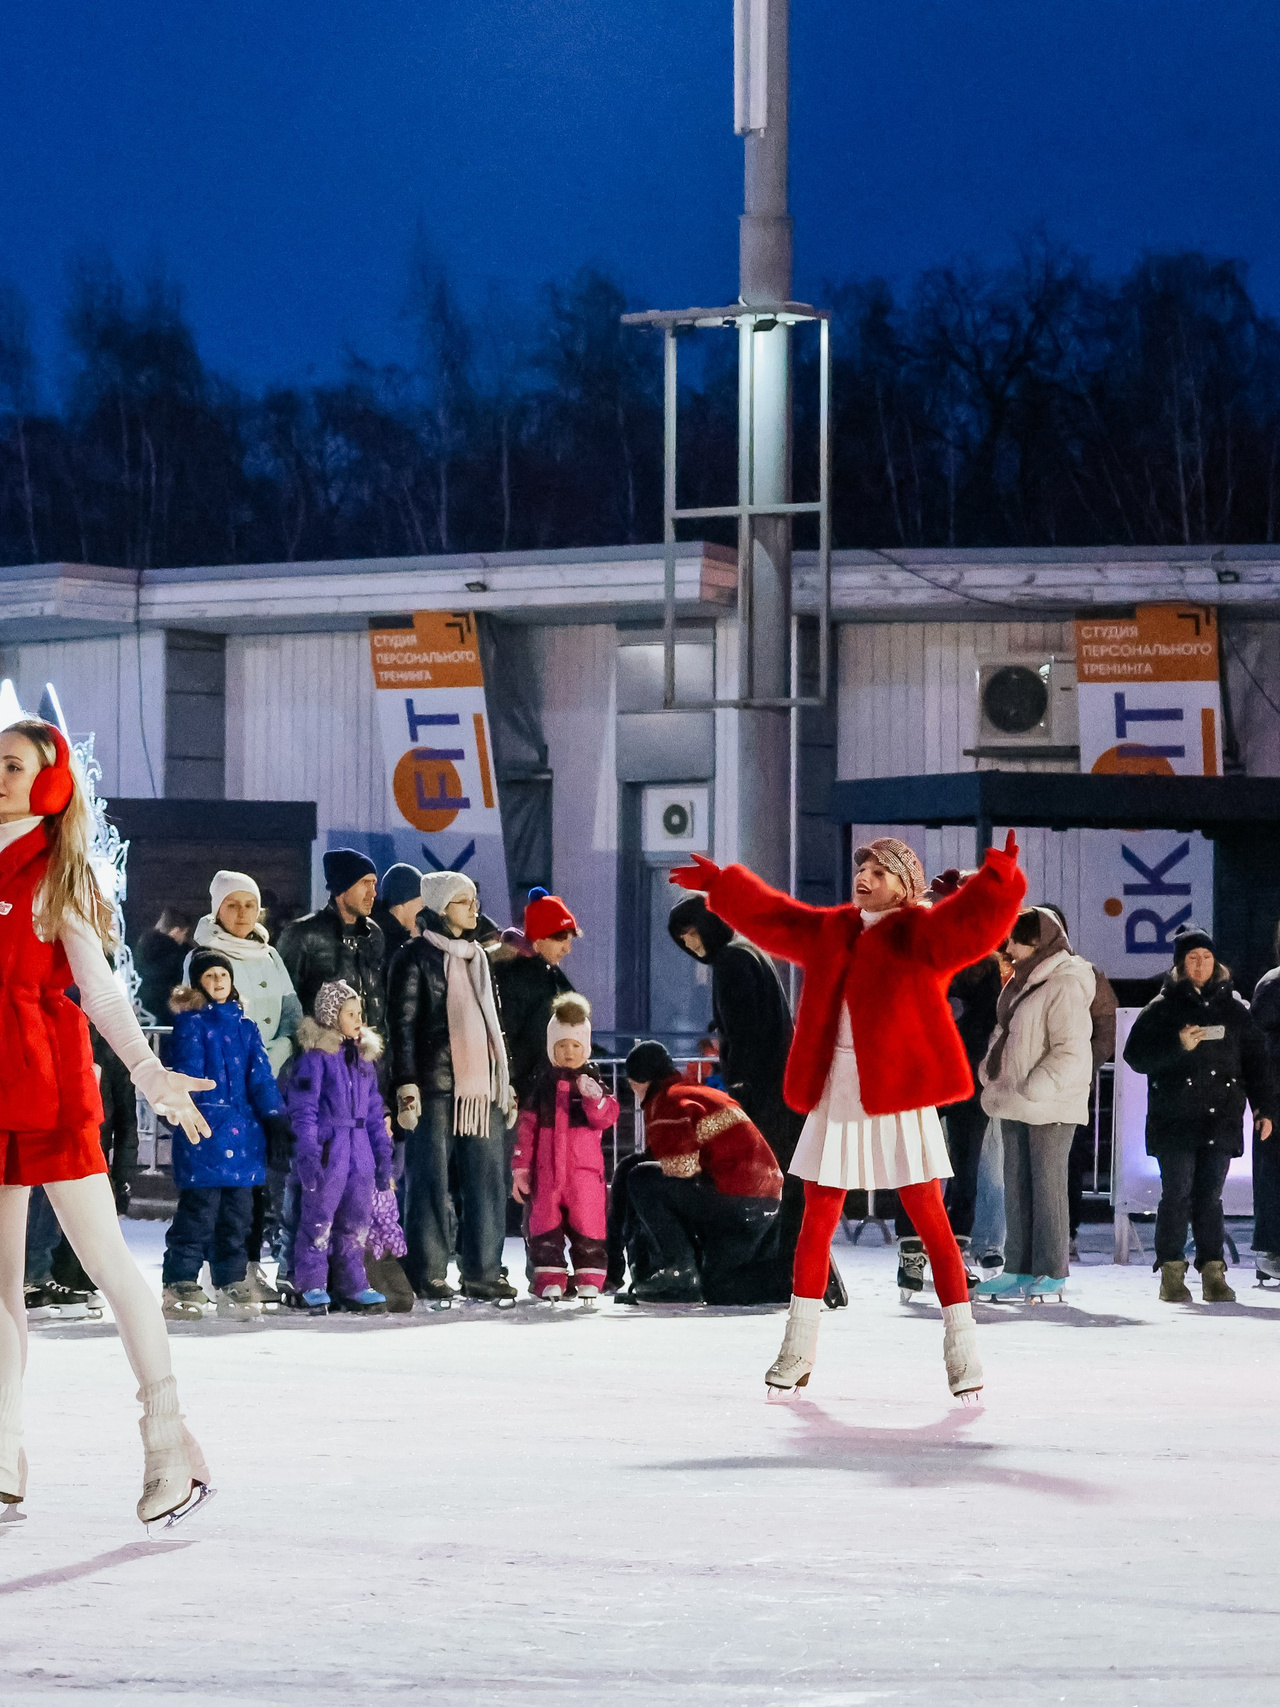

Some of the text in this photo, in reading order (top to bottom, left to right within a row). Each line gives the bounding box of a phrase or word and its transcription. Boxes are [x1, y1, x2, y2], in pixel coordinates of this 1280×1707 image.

[1081, 625, 1138, 639] СТУДИЯ
[373, 634, 418, 649] СТУДИЯ
[1082, 642, 1213, 657] ПЕРСОНАЛЬНОГО
[376, 650, 476, 664] ПЕРСОНАЛЬНОГО
[378, 669, 432, 682] ТРЕНИНГА
[1083, 662, 1153, 675] ТРЕНИНГА
[1114, 692, 1186, 758] IT
